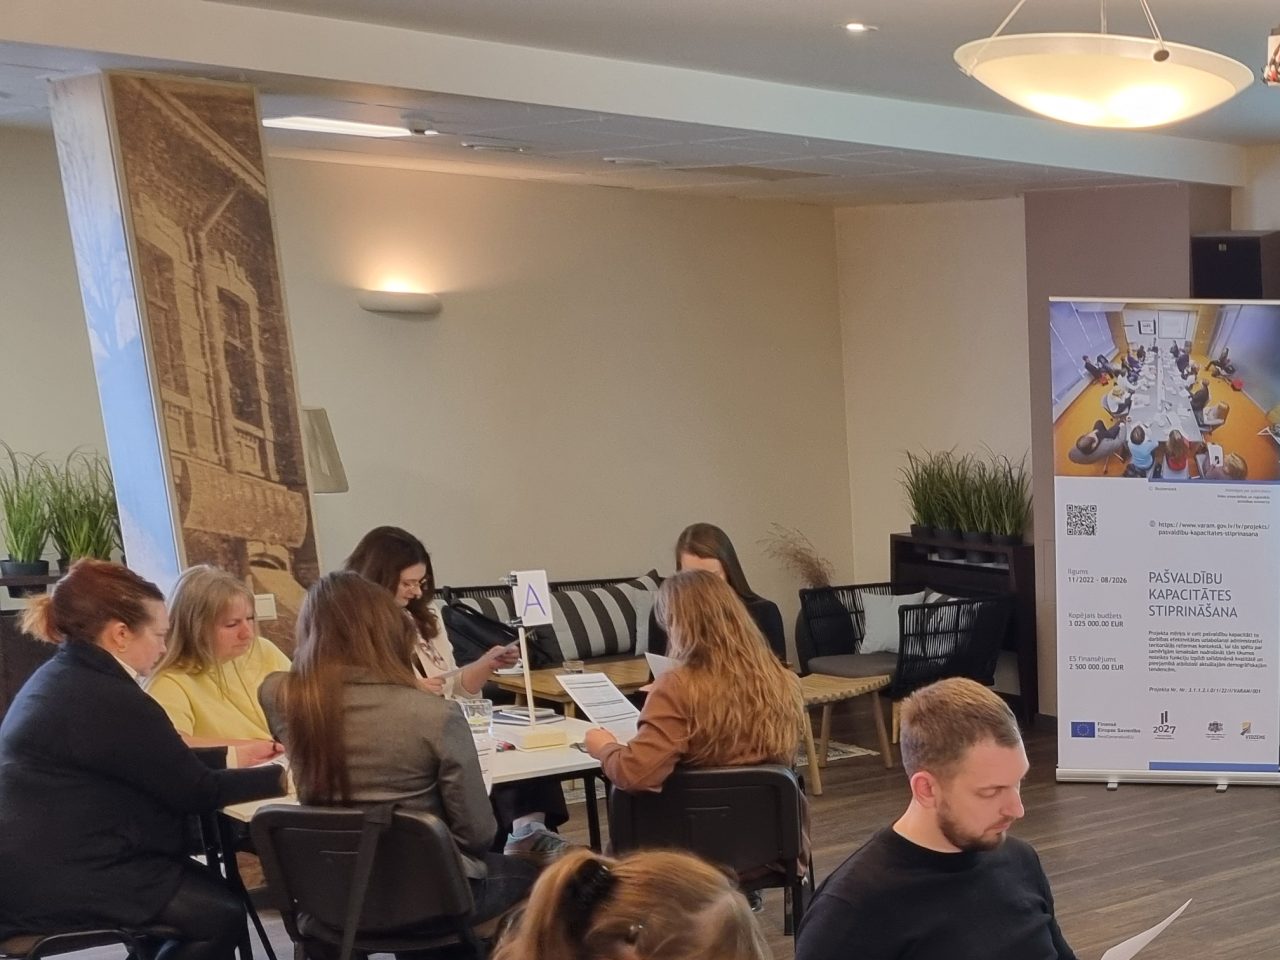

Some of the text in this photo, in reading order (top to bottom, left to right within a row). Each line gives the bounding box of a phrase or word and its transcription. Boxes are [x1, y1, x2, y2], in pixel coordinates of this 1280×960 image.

[1067, 568, 1089, 576] Ilgums
[1148, 569, 1222, 584] PAŠVALDĪBU
[523, 584, 546, 616] A
[1148, 587, 1231, 601] KAPACITĀTES
[1068, 612, 1123, 620] Kopējais budžets
[1148, 603, 1238, 617] STIPRINĀŠANA
[1078, 656, 1117, 664] finansējums
[1152, 724, 1176, 735] 2027
